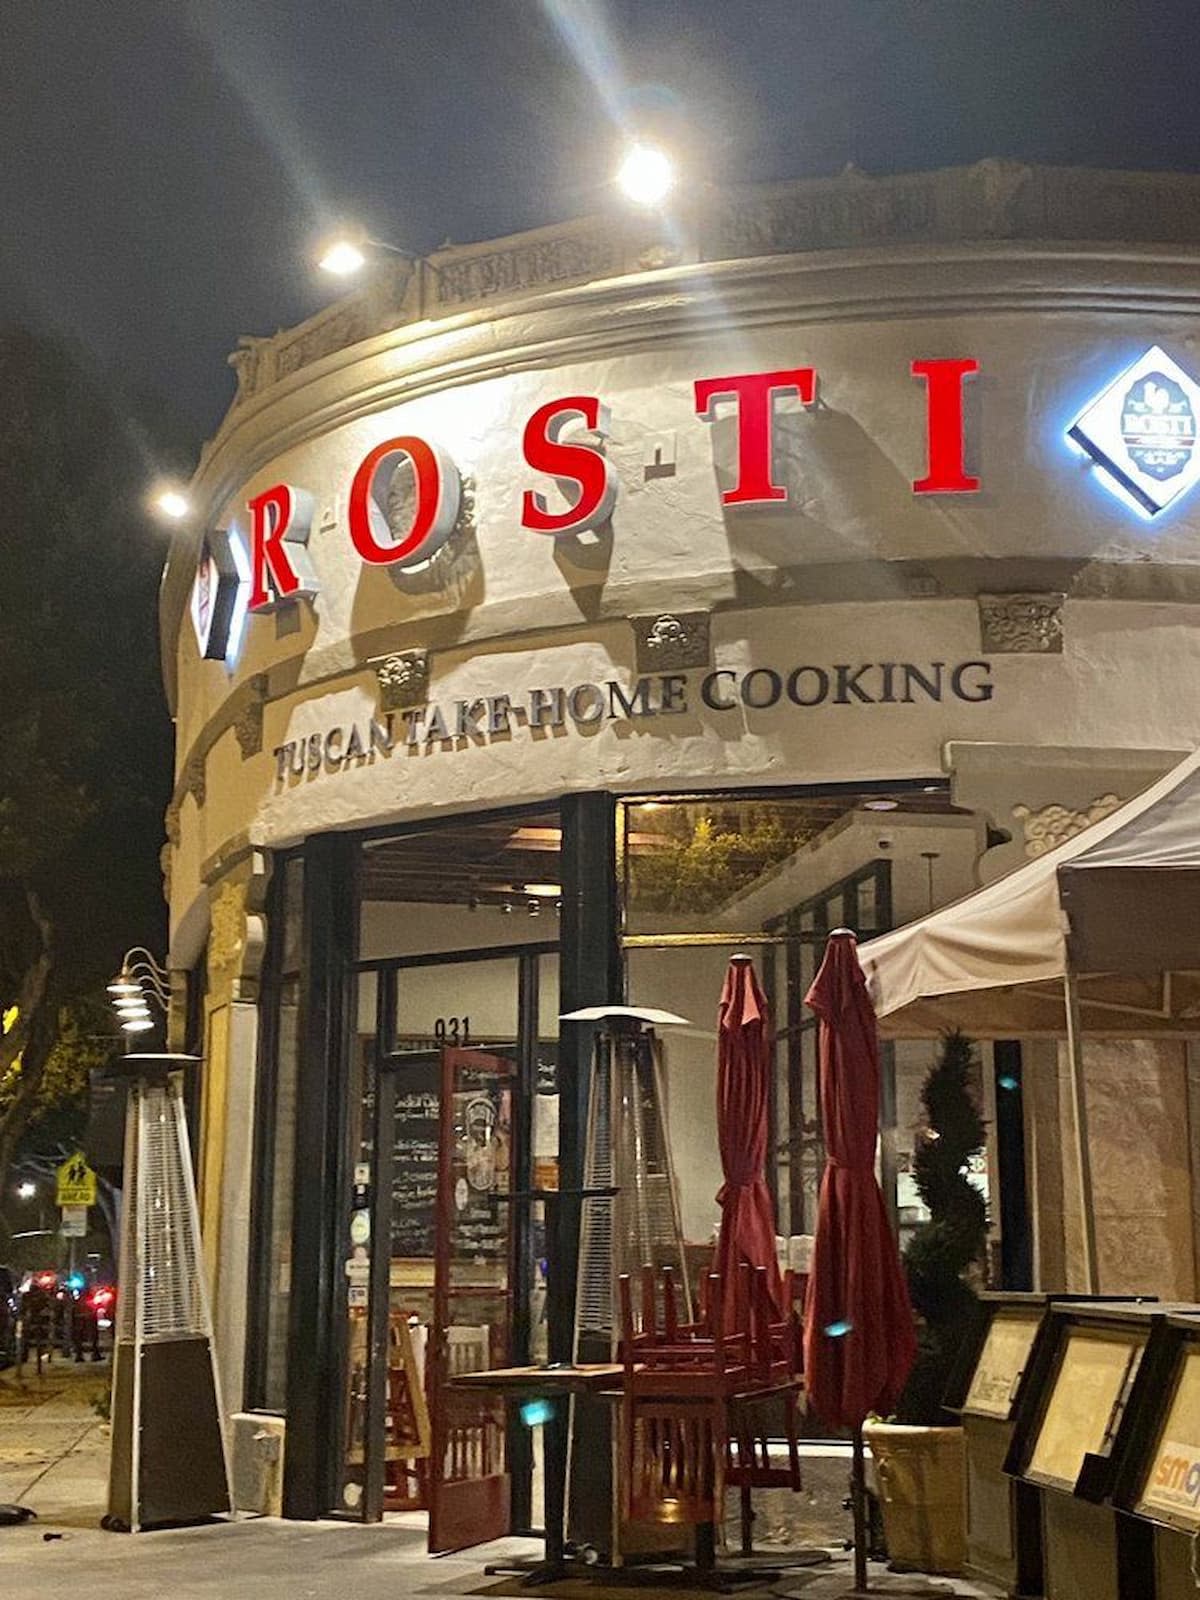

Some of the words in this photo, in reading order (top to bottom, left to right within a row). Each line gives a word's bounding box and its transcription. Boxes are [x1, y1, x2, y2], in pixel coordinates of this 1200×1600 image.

[247, 358, 981, 613] ROSTI
[273, 713, 394, 782] TUSCAN
[701, 661, 994, 711] COOKING
